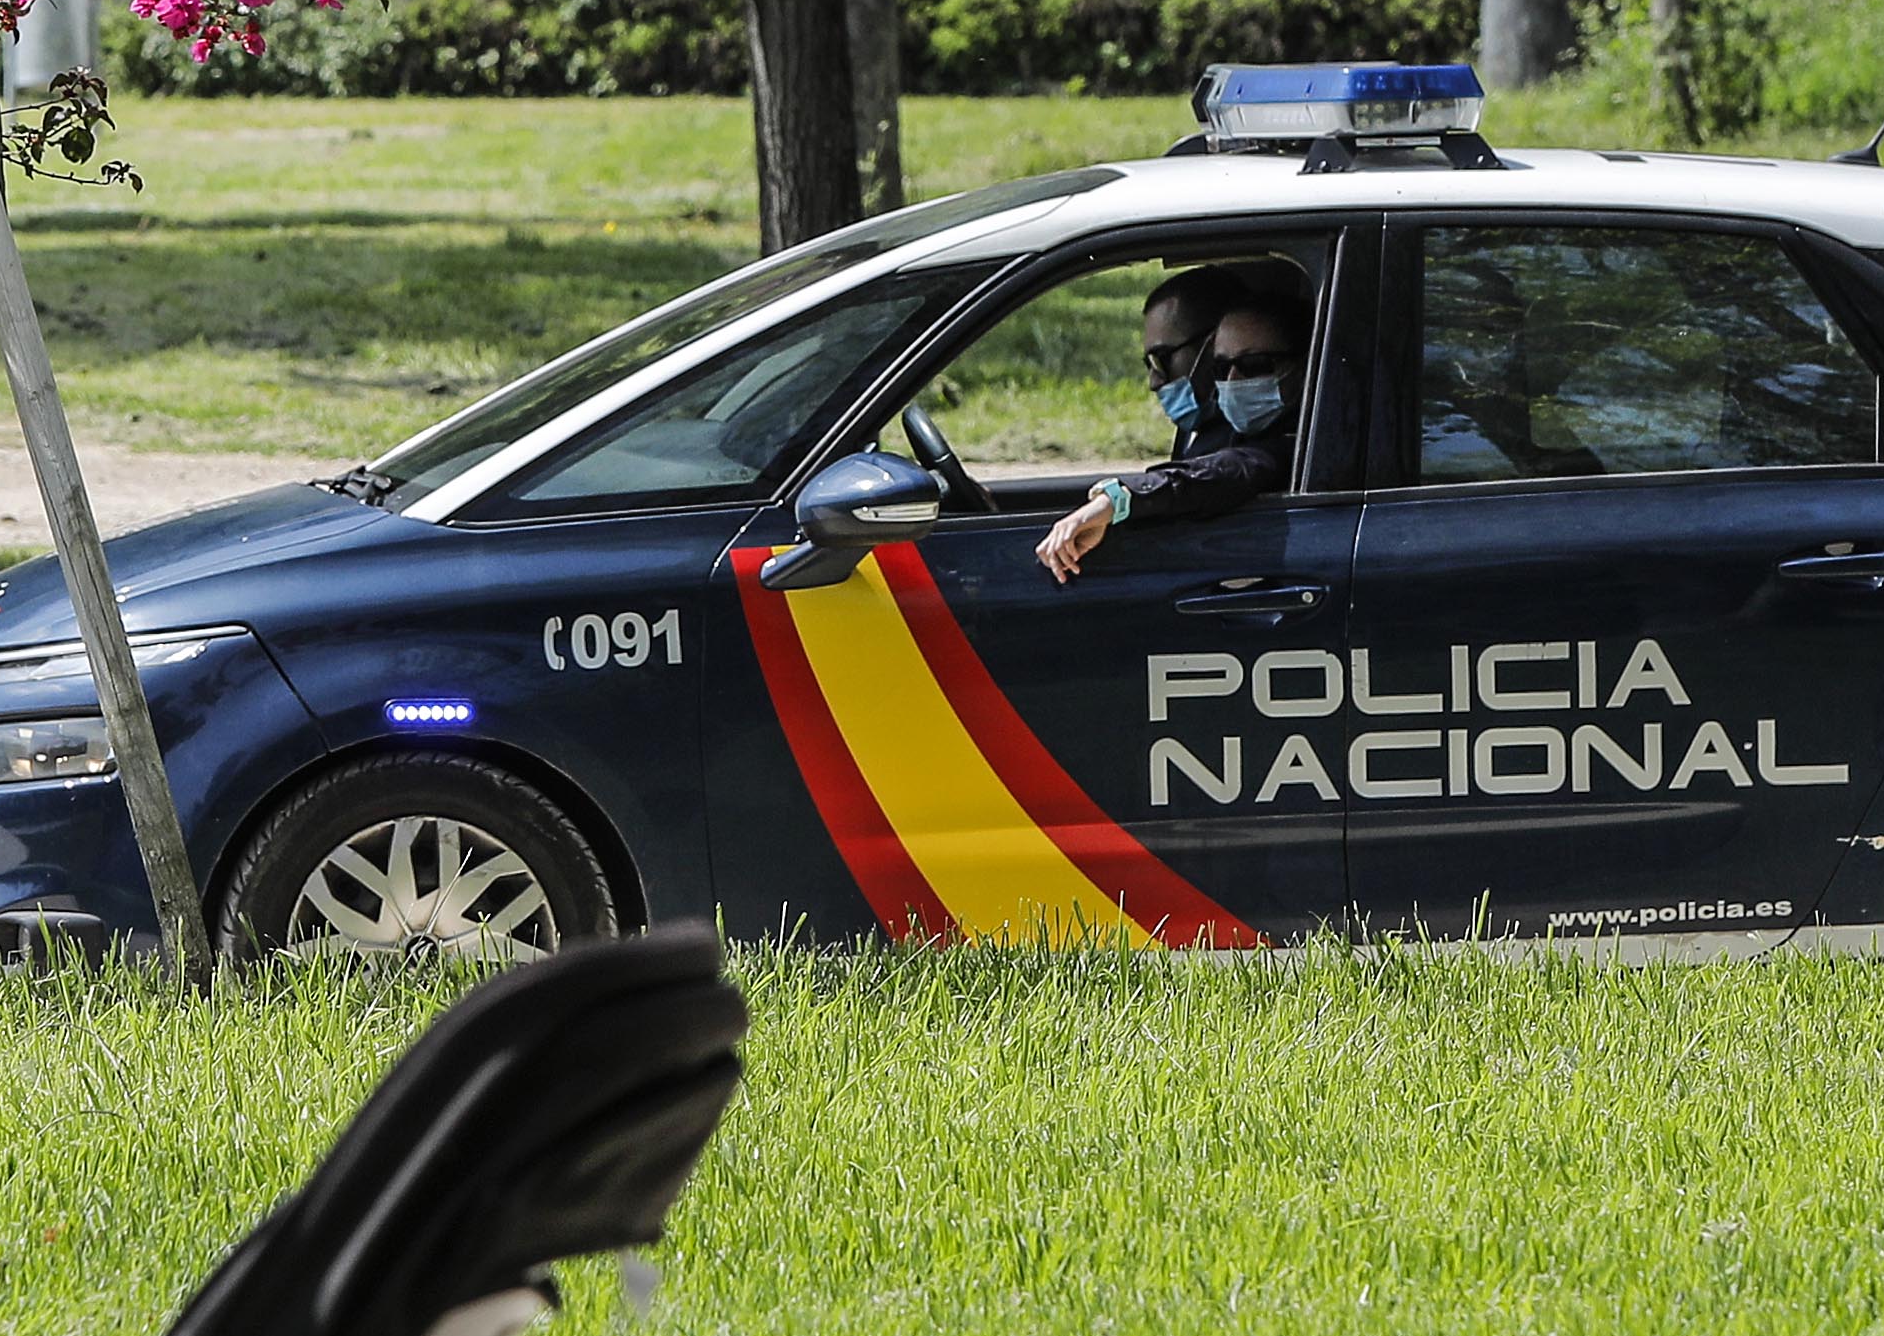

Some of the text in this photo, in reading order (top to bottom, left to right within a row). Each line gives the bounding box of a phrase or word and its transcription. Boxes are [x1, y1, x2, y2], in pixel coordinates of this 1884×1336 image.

[571, 609, 683, 669] 091
[1147, 638, 1692, 722] POLICIA
[1148, 718, 1850, 806] NACIONAL
[1549, 899, 1793, 927] www.policia.es
